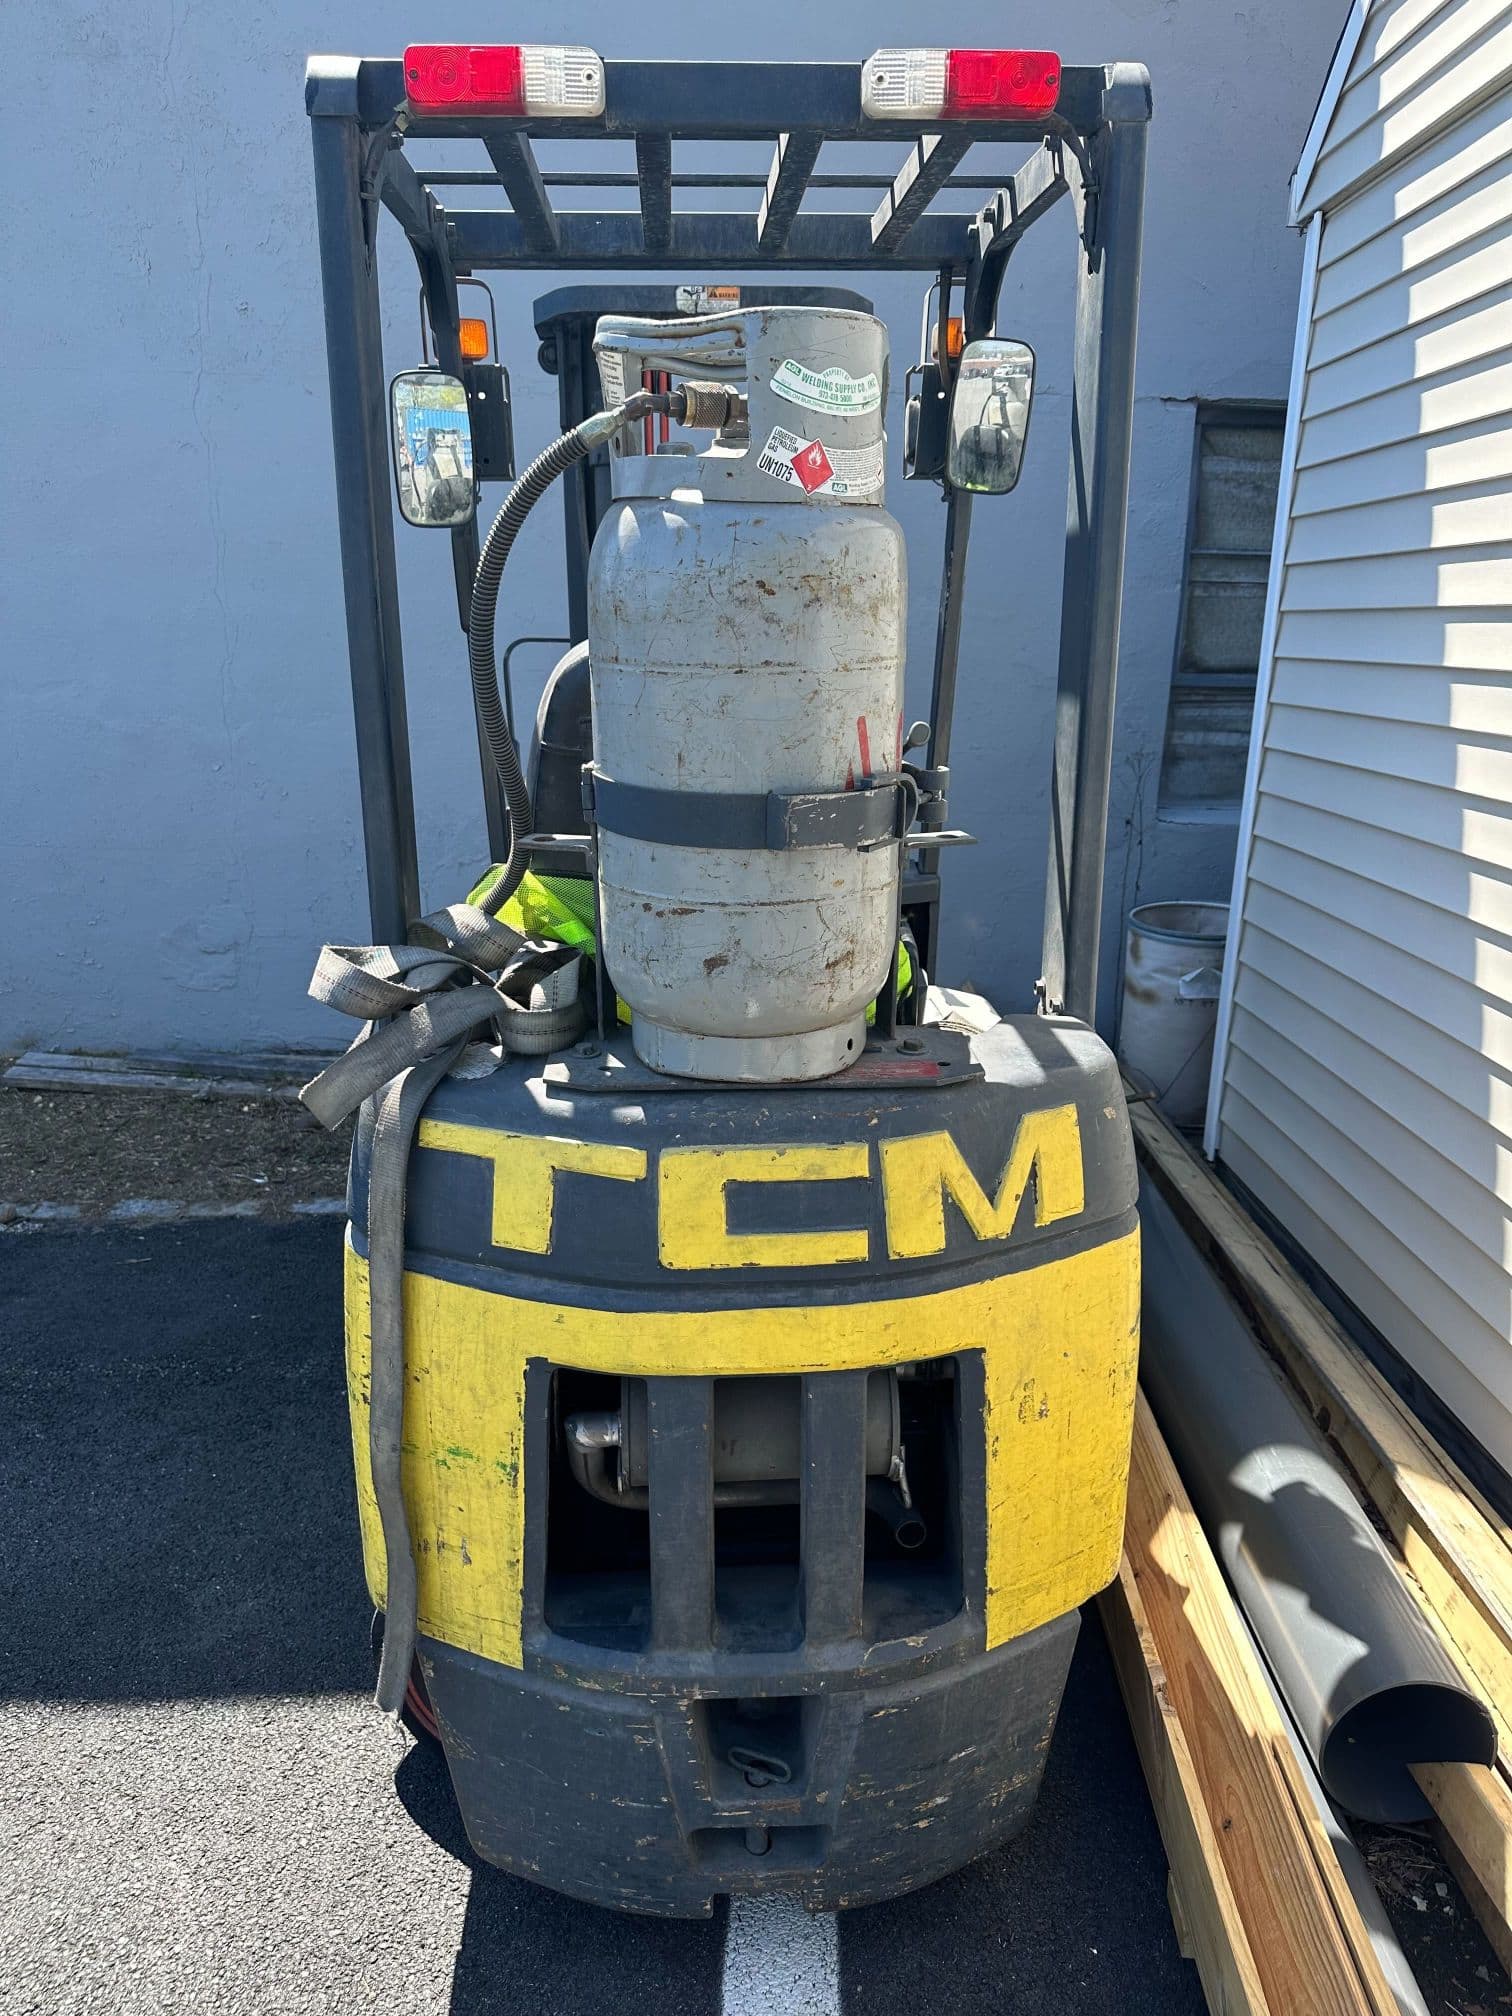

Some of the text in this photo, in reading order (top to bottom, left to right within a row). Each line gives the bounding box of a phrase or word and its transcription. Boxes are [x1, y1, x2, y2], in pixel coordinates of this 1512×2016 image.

[801, 371, 833, 392] WELDING
[834, 382, 857, 394] SUPPLY
[771, 435, 799, 454] PETROLEUM
[774, 427, 798, 445] LIQUEFIED
[767, 442, 779, 453] GAS
[758, 453, 794, 482] UN1075
[419, 1103, 1083, 1270] TCM
